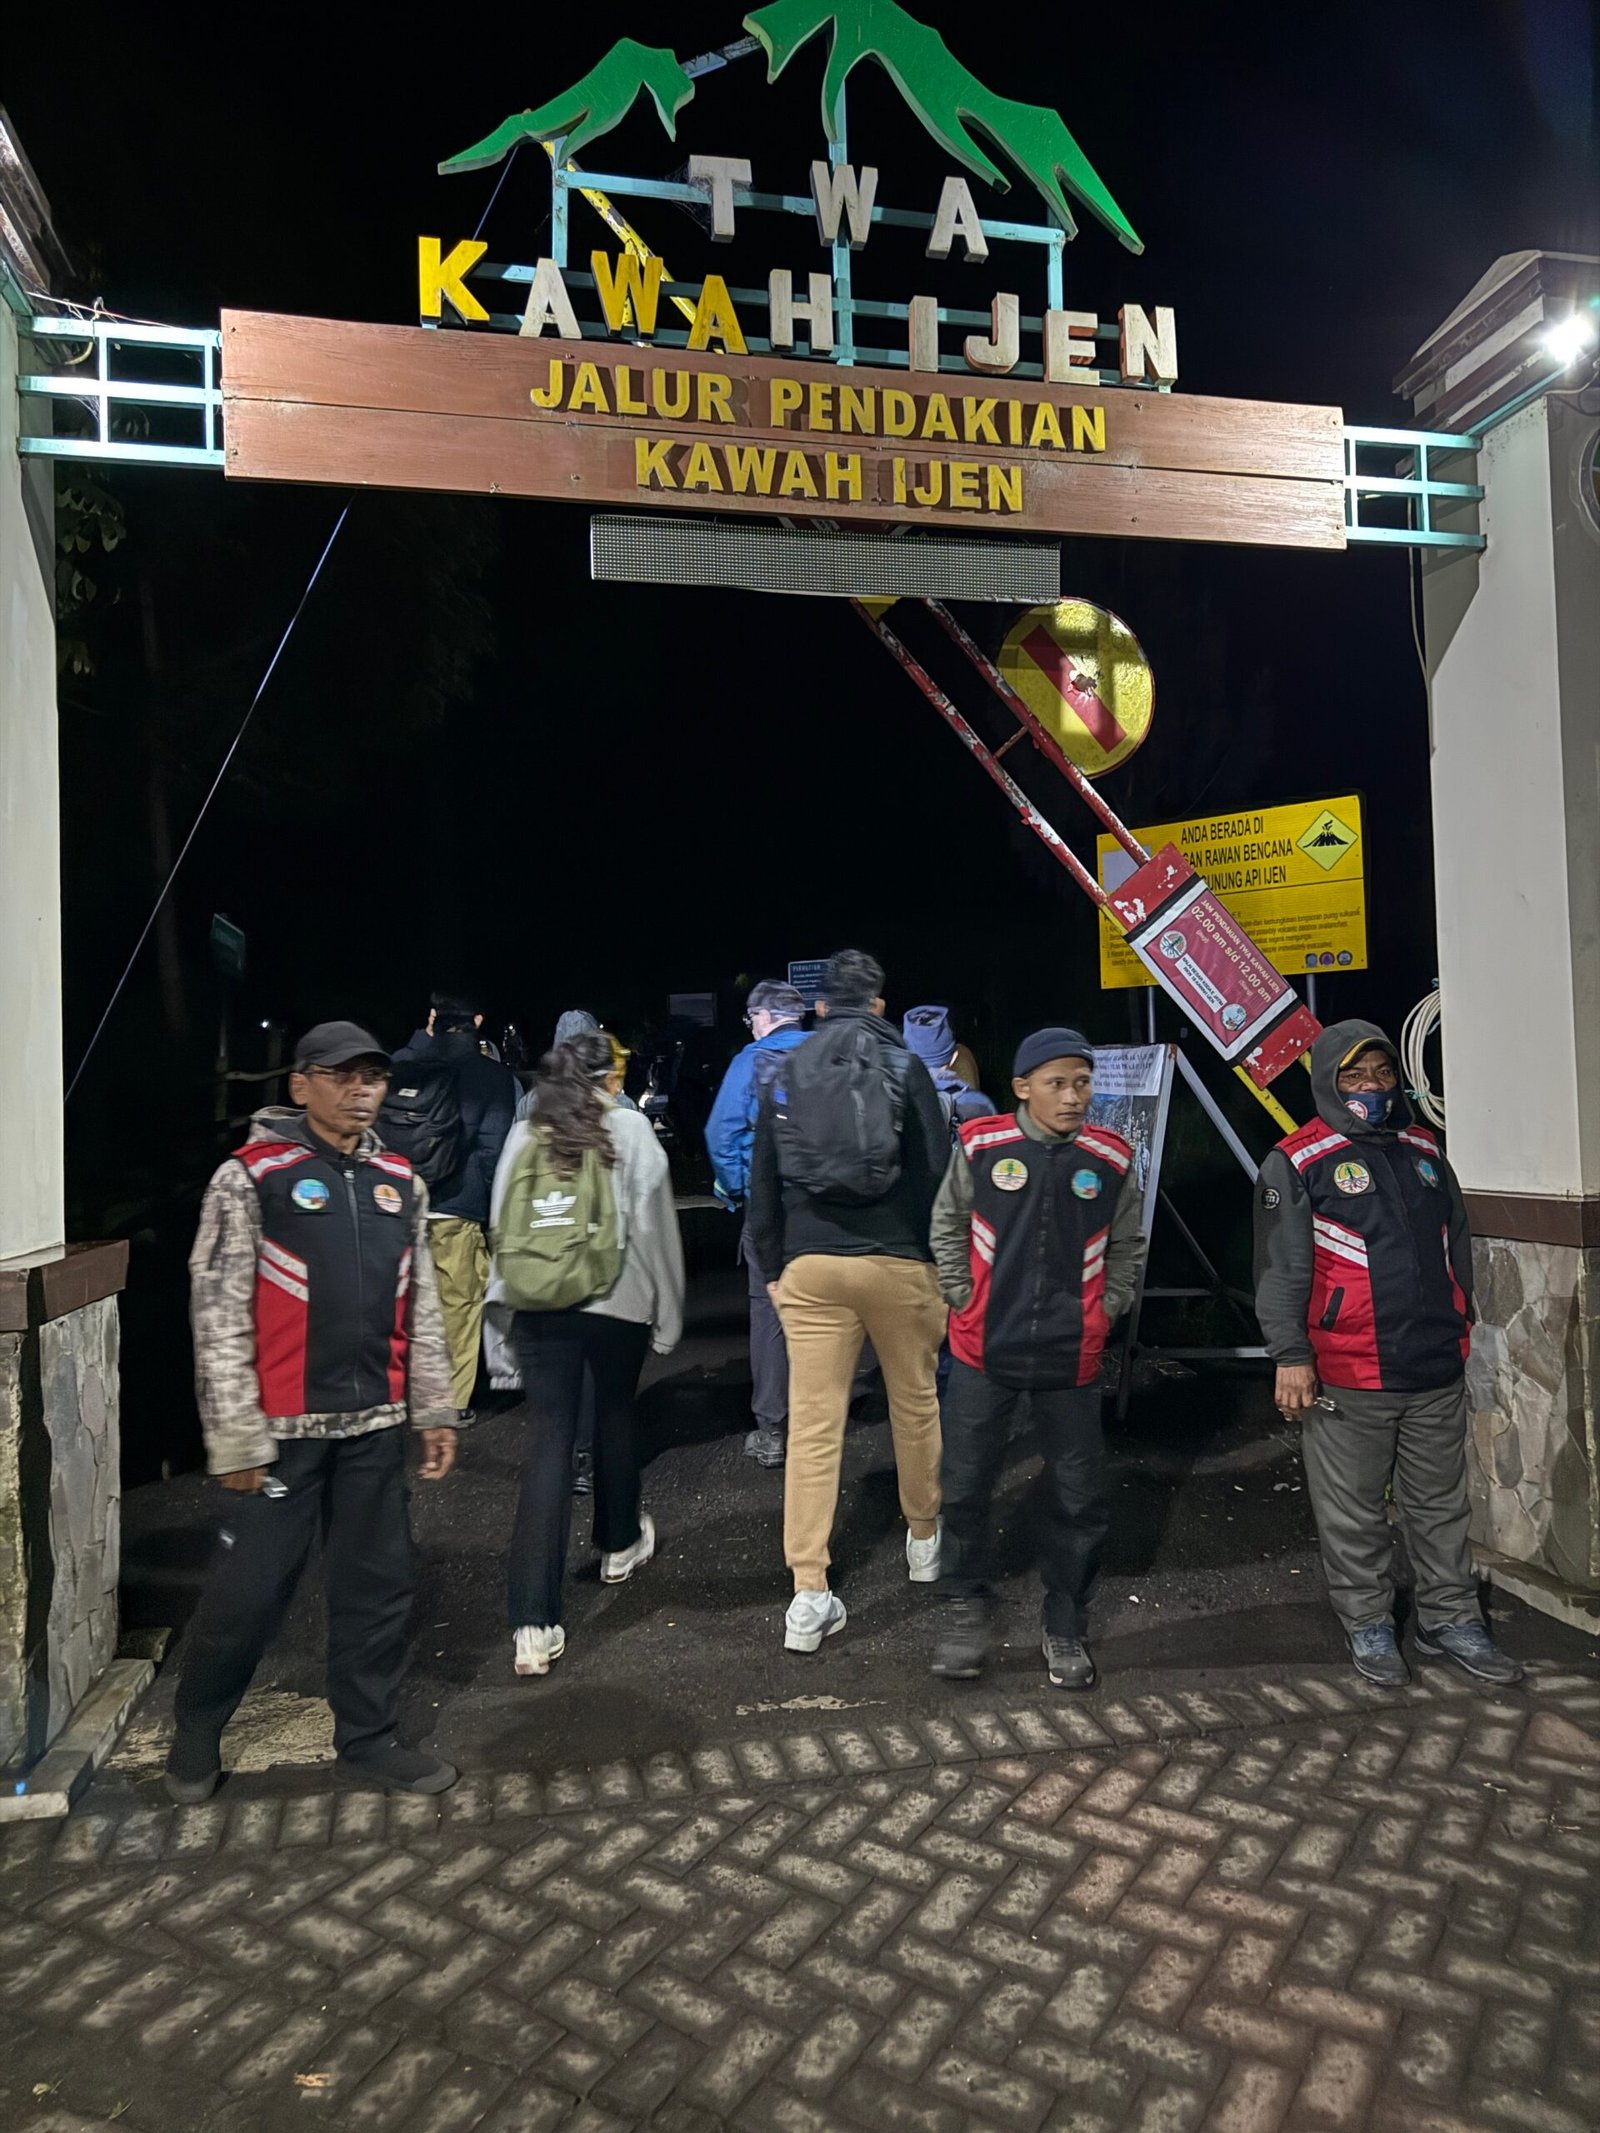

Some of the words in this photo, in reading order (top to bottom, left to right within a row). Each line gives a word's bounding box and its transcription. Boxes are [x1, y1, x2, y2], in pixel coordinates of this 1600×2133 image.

[418, 236, 834, 355] KAWAH
[908, 292, 1178, 386] IJEN
[530, 360, 735, 424] JALUR
[770, 378, 1106, 452] PENDAKIAN
[634, 437, 863, 501] KAWAH
[892, 457, 1023, 513] IJEN
[1181, 823, 1209, 845] ANDA
[1211, 817, 1251, 841] BERADA
[1254, 816, 1264, 834] DI
[1206, 845, 1241, 867] RAWAN
[1244, 838, 1294, 862] BENCANA
[1245, 867, 1261, 888] API
[1263, 865, 1287, 885] IJEN
[1190, 905, 1215, 933] 02.00
[1212, 932, 1226, 948] am
[1224, 945, 1240, 962] s/d
[1237, 960, 1260, 987] 12.00
[1257, 987, 1271, 1002] am
[1201, 899, 1214, 912] JAM
[1212, 911, 1241, 945] PENDAKIAN
[1239, 944, 1252, 958] TWA
[1250, 957, 1269, 979] KAWAH
[1267, 979, 1280, 992] IJEN
